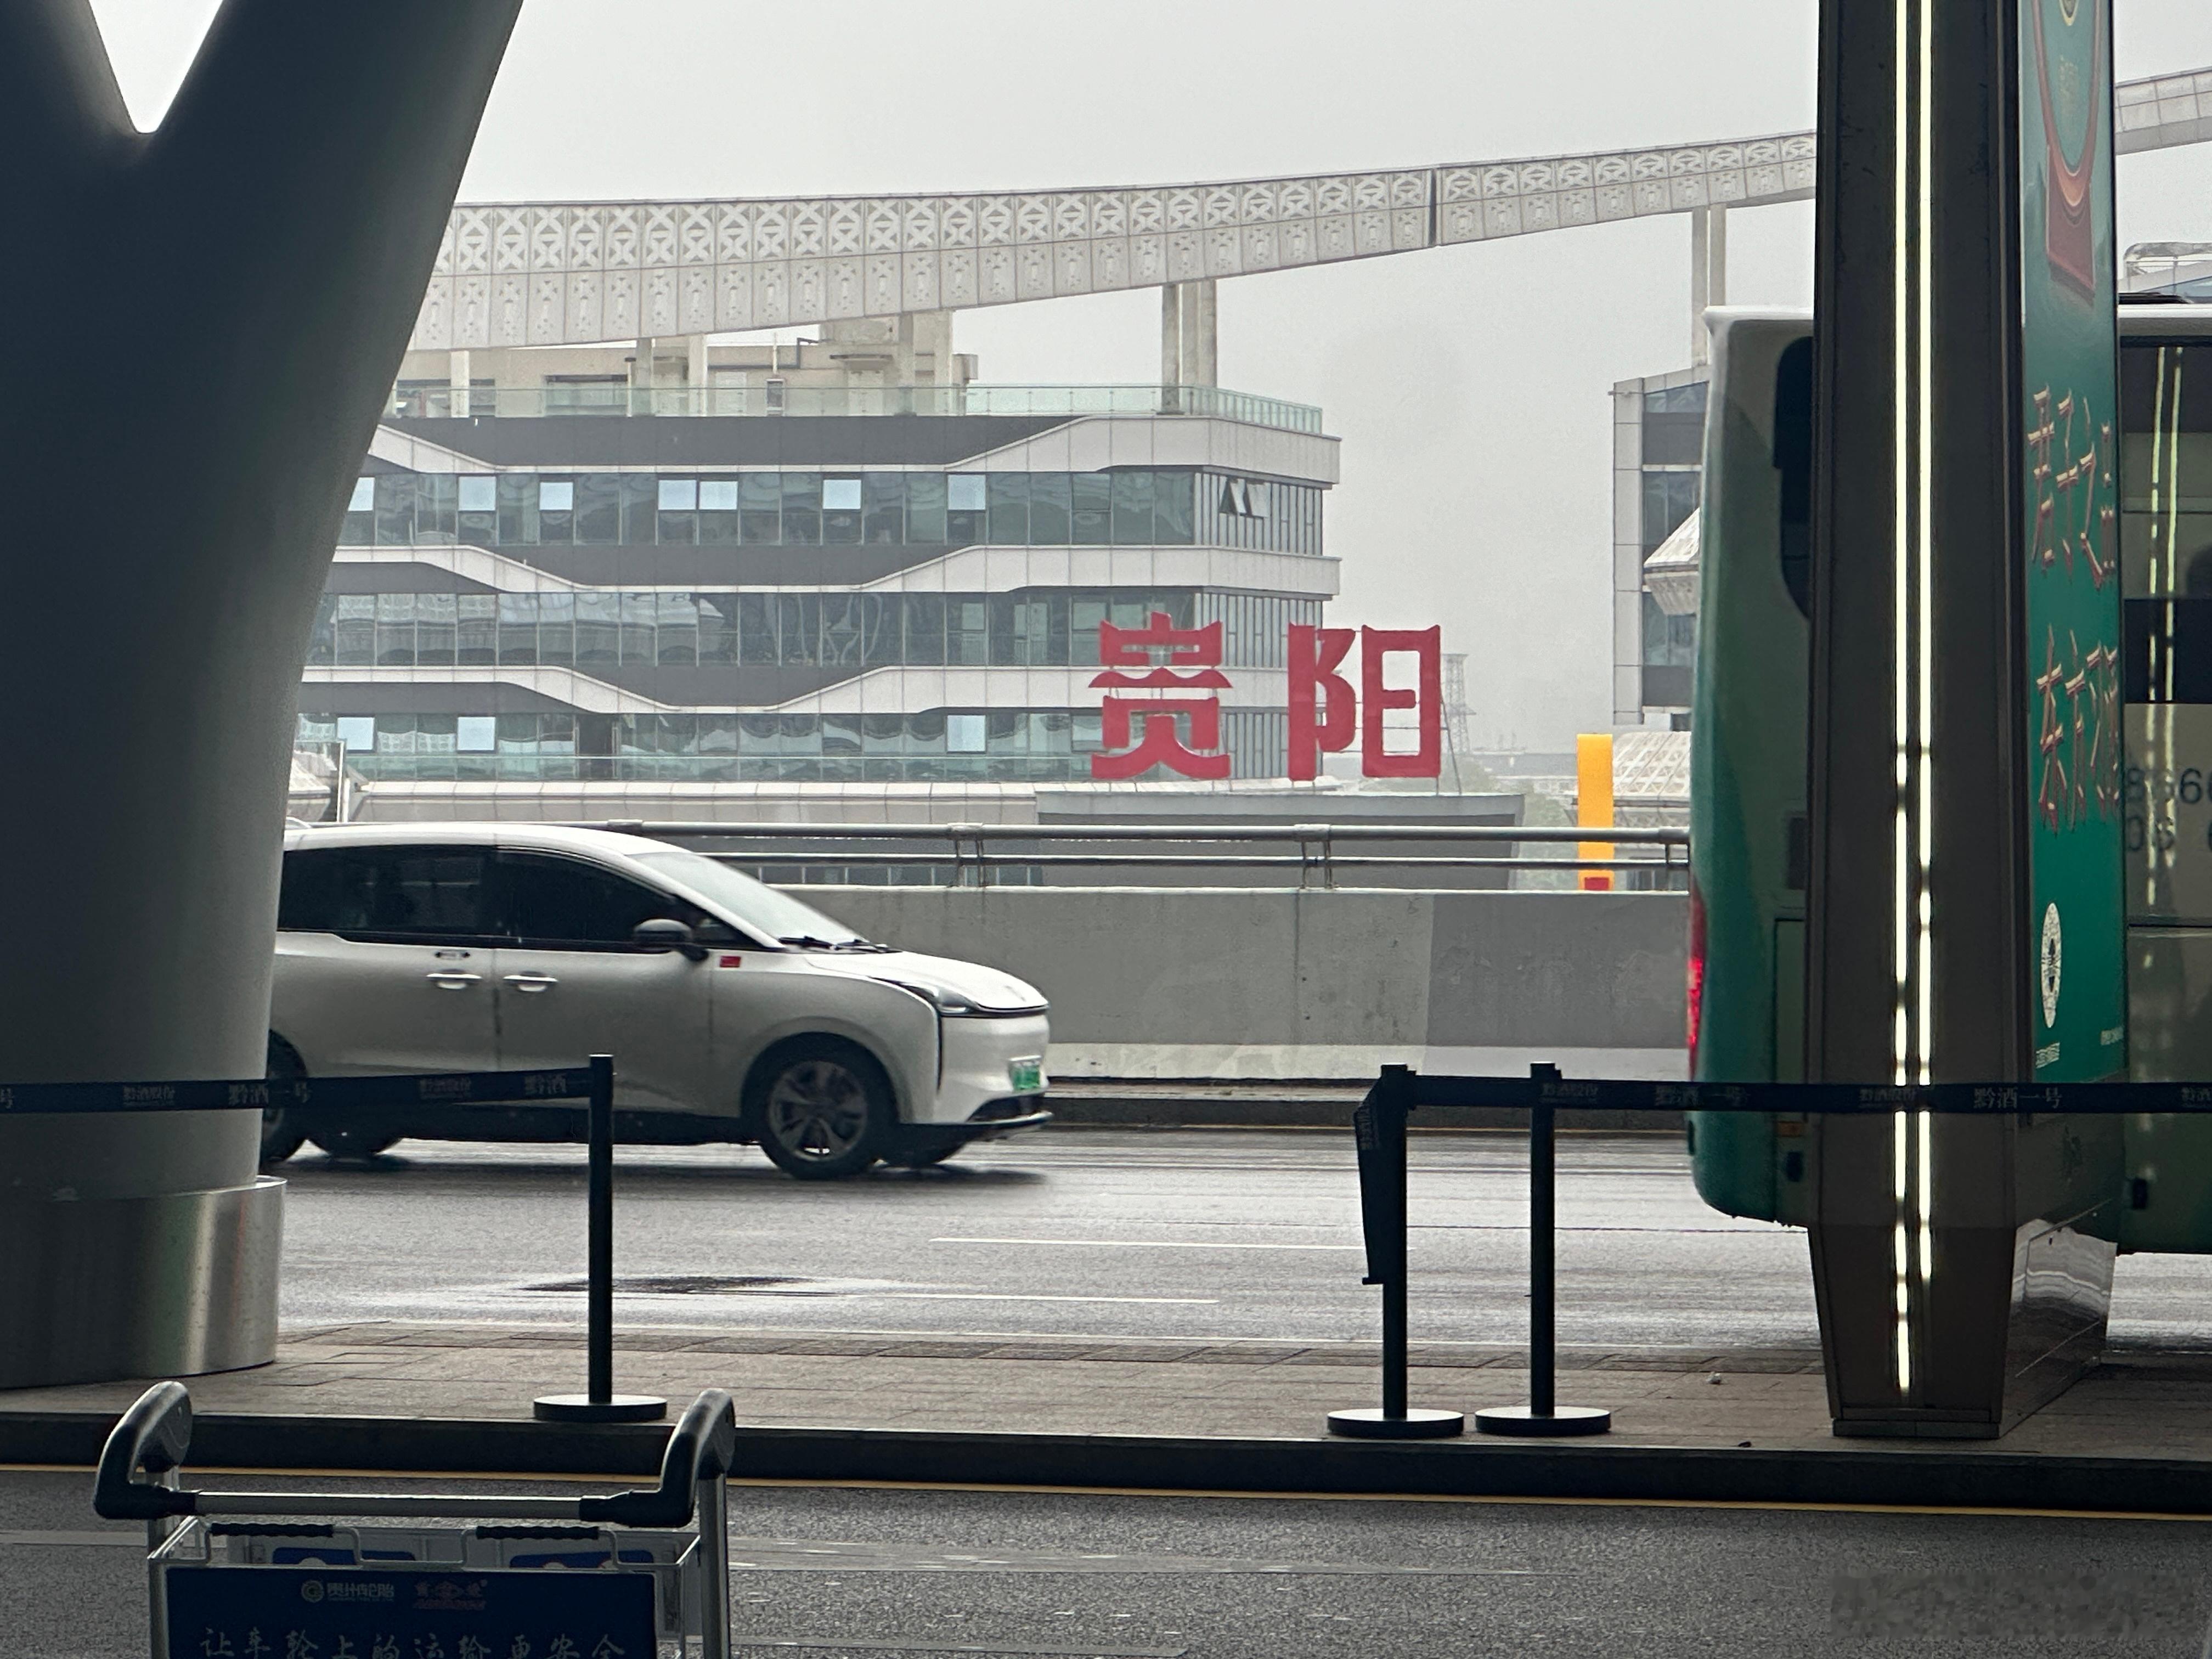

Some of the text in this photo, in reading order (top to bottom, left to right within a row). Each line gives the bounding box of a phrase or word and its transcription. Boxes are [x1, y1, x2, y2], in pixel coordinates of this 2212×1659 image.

[1088, 611, 1441, 782] 贵阳
[1973, 1086, 2063, 1109] 黔酒一号
